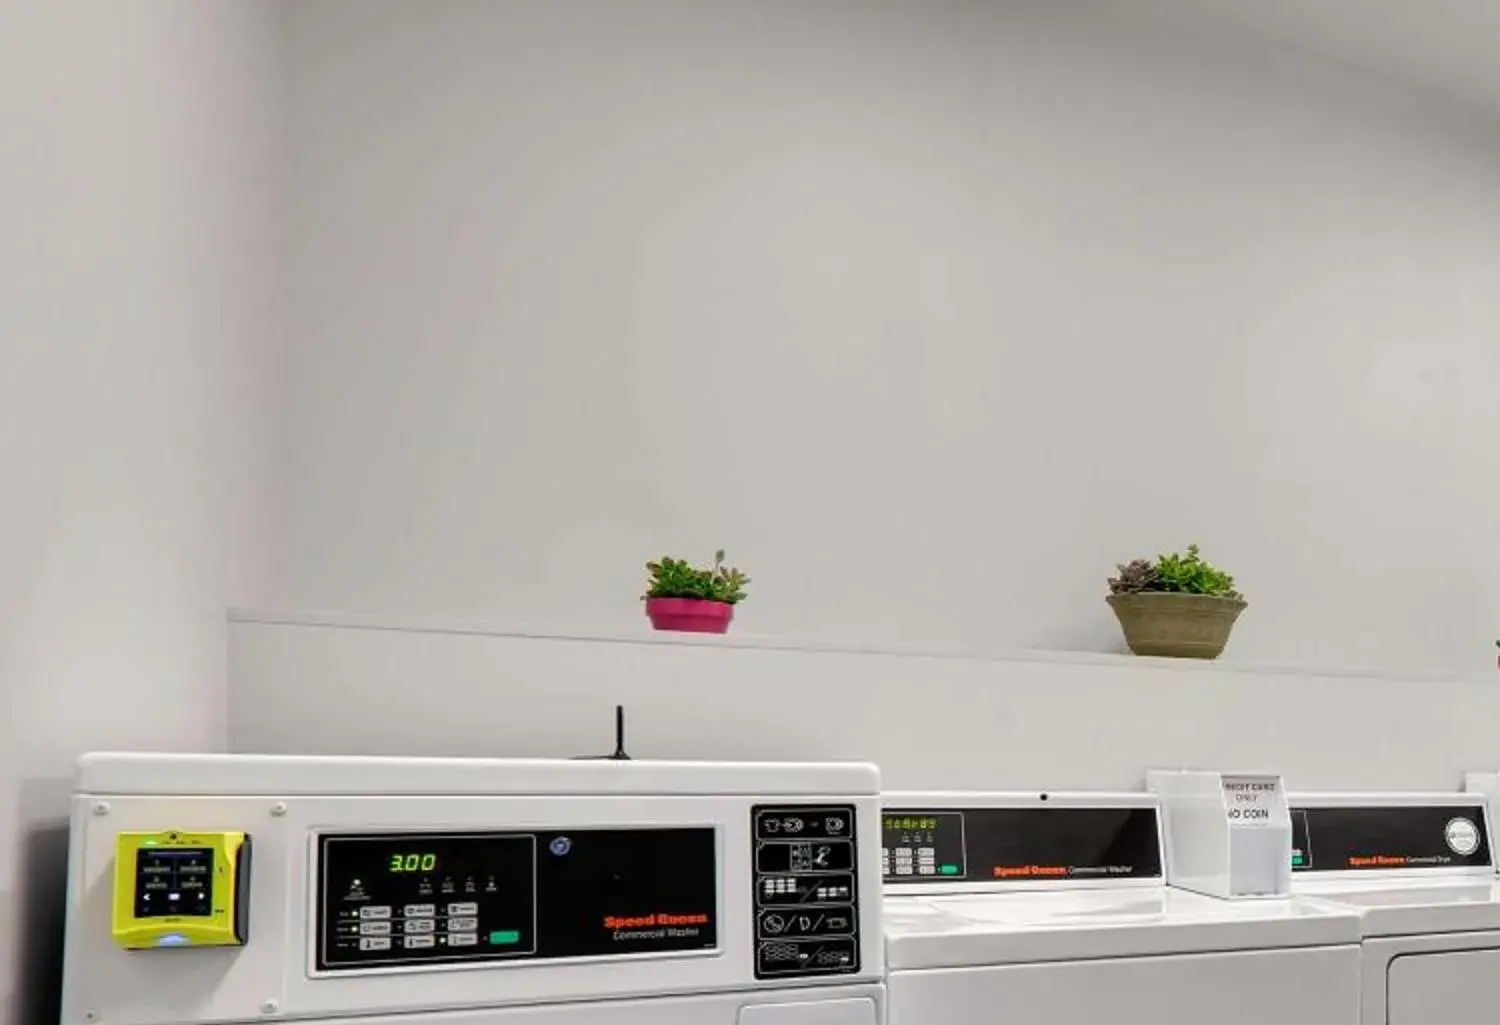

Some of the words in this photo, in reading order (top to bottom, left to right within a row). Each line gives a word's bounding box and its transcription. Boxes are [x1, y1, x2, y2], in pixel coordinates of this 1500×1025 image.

[1244, 808, 1269, 819] COIN
[993, 865, 1029, 877] Speed
[1031, 865, 1066, 876] Queen
[604, 914, 654, 928] Speed
[658, 913, 708, 925] Queen
[613, 928, 665, 941] Commercial
